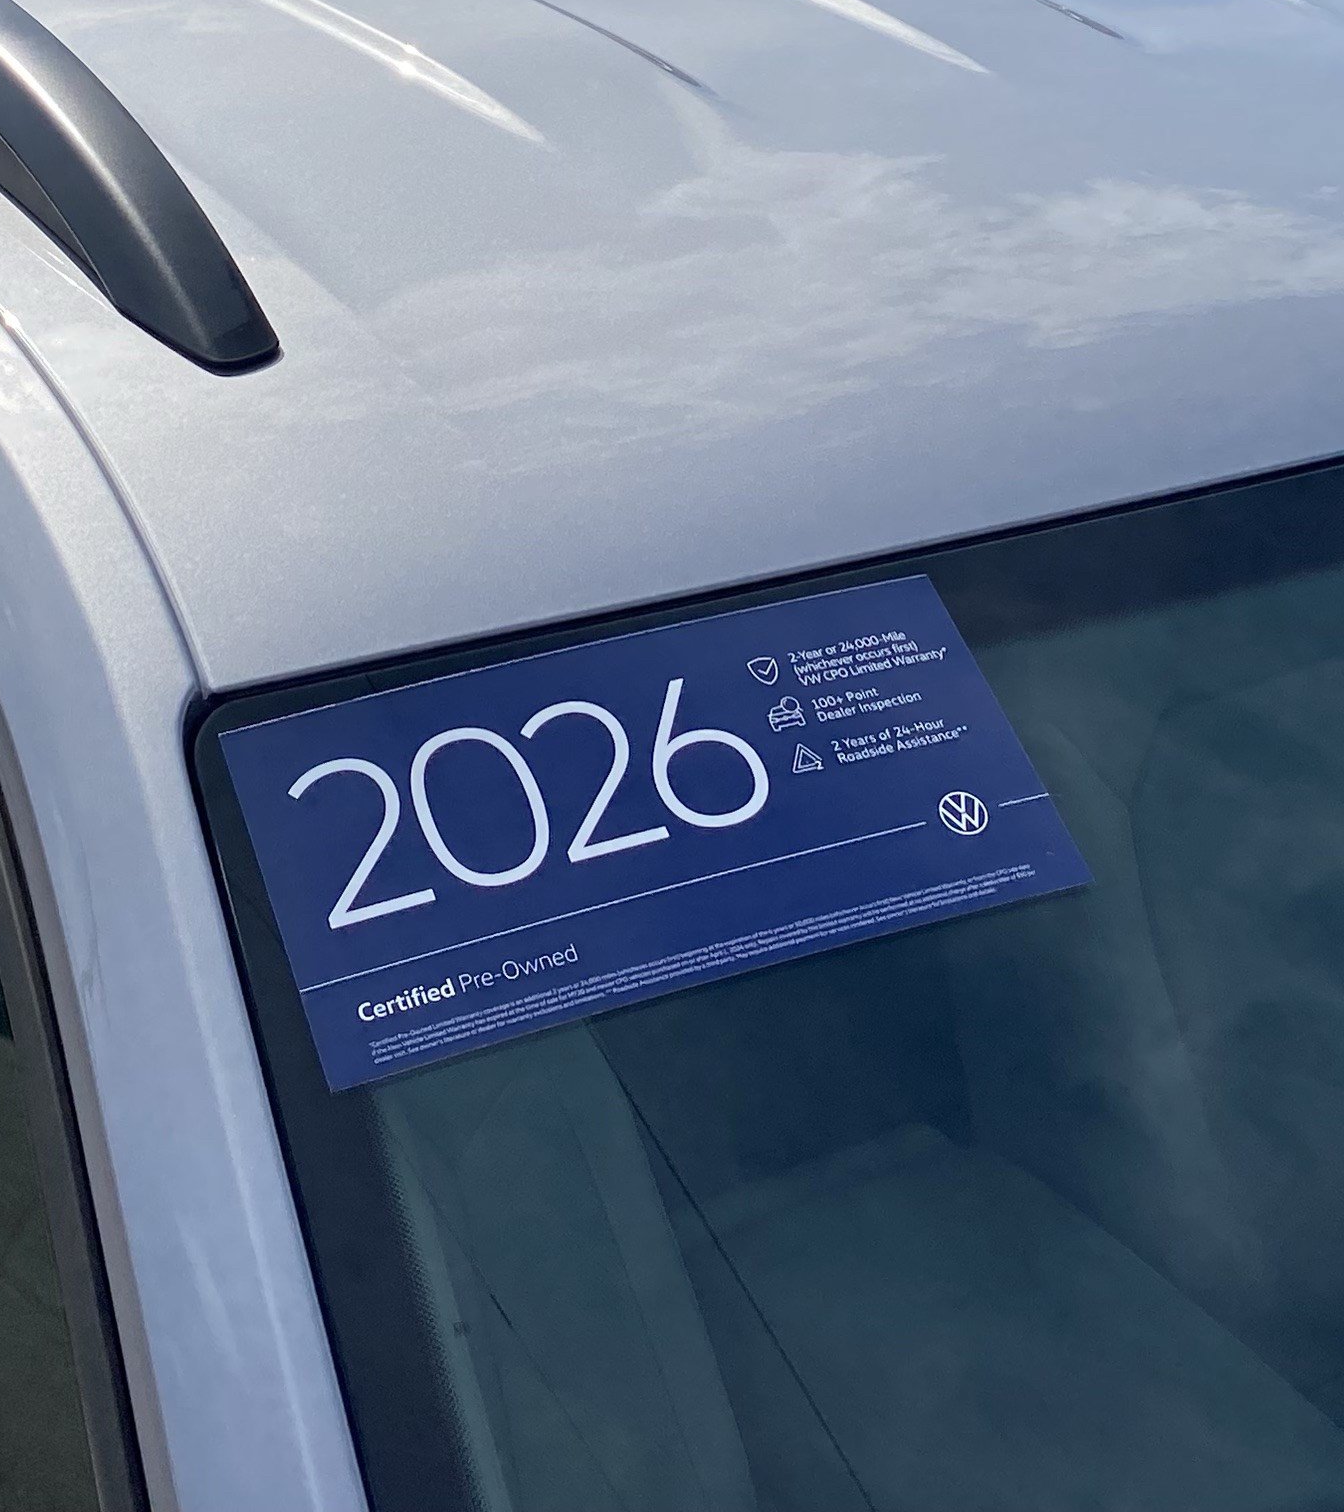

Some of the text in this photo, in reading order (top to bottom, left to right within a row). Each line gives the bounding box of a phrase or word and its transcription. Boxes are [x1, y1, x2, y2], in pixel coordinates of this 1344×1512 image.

[787, 630, 907, 663] 2-Year or 24,000-Mile
[793, 640, 919, 676] (whichever occurs first)
[797, 673, 823, 687] VW
[823, 666, 849, 682] CPO
[849, 655, 892, 677] Limited
[811, 687, 879, 710] 100+ Point
[816, 691, 922, 722] Dealer Inspection
[830, 719, 945, 752] 2 Years of 24-Hour
[837, 742, 896, 765] Roadside
[288, 678, 769, 929] 2026
[938, 790, 989, 837] VW
[357, 943, 579, 1023] Certified Pre-Owned
